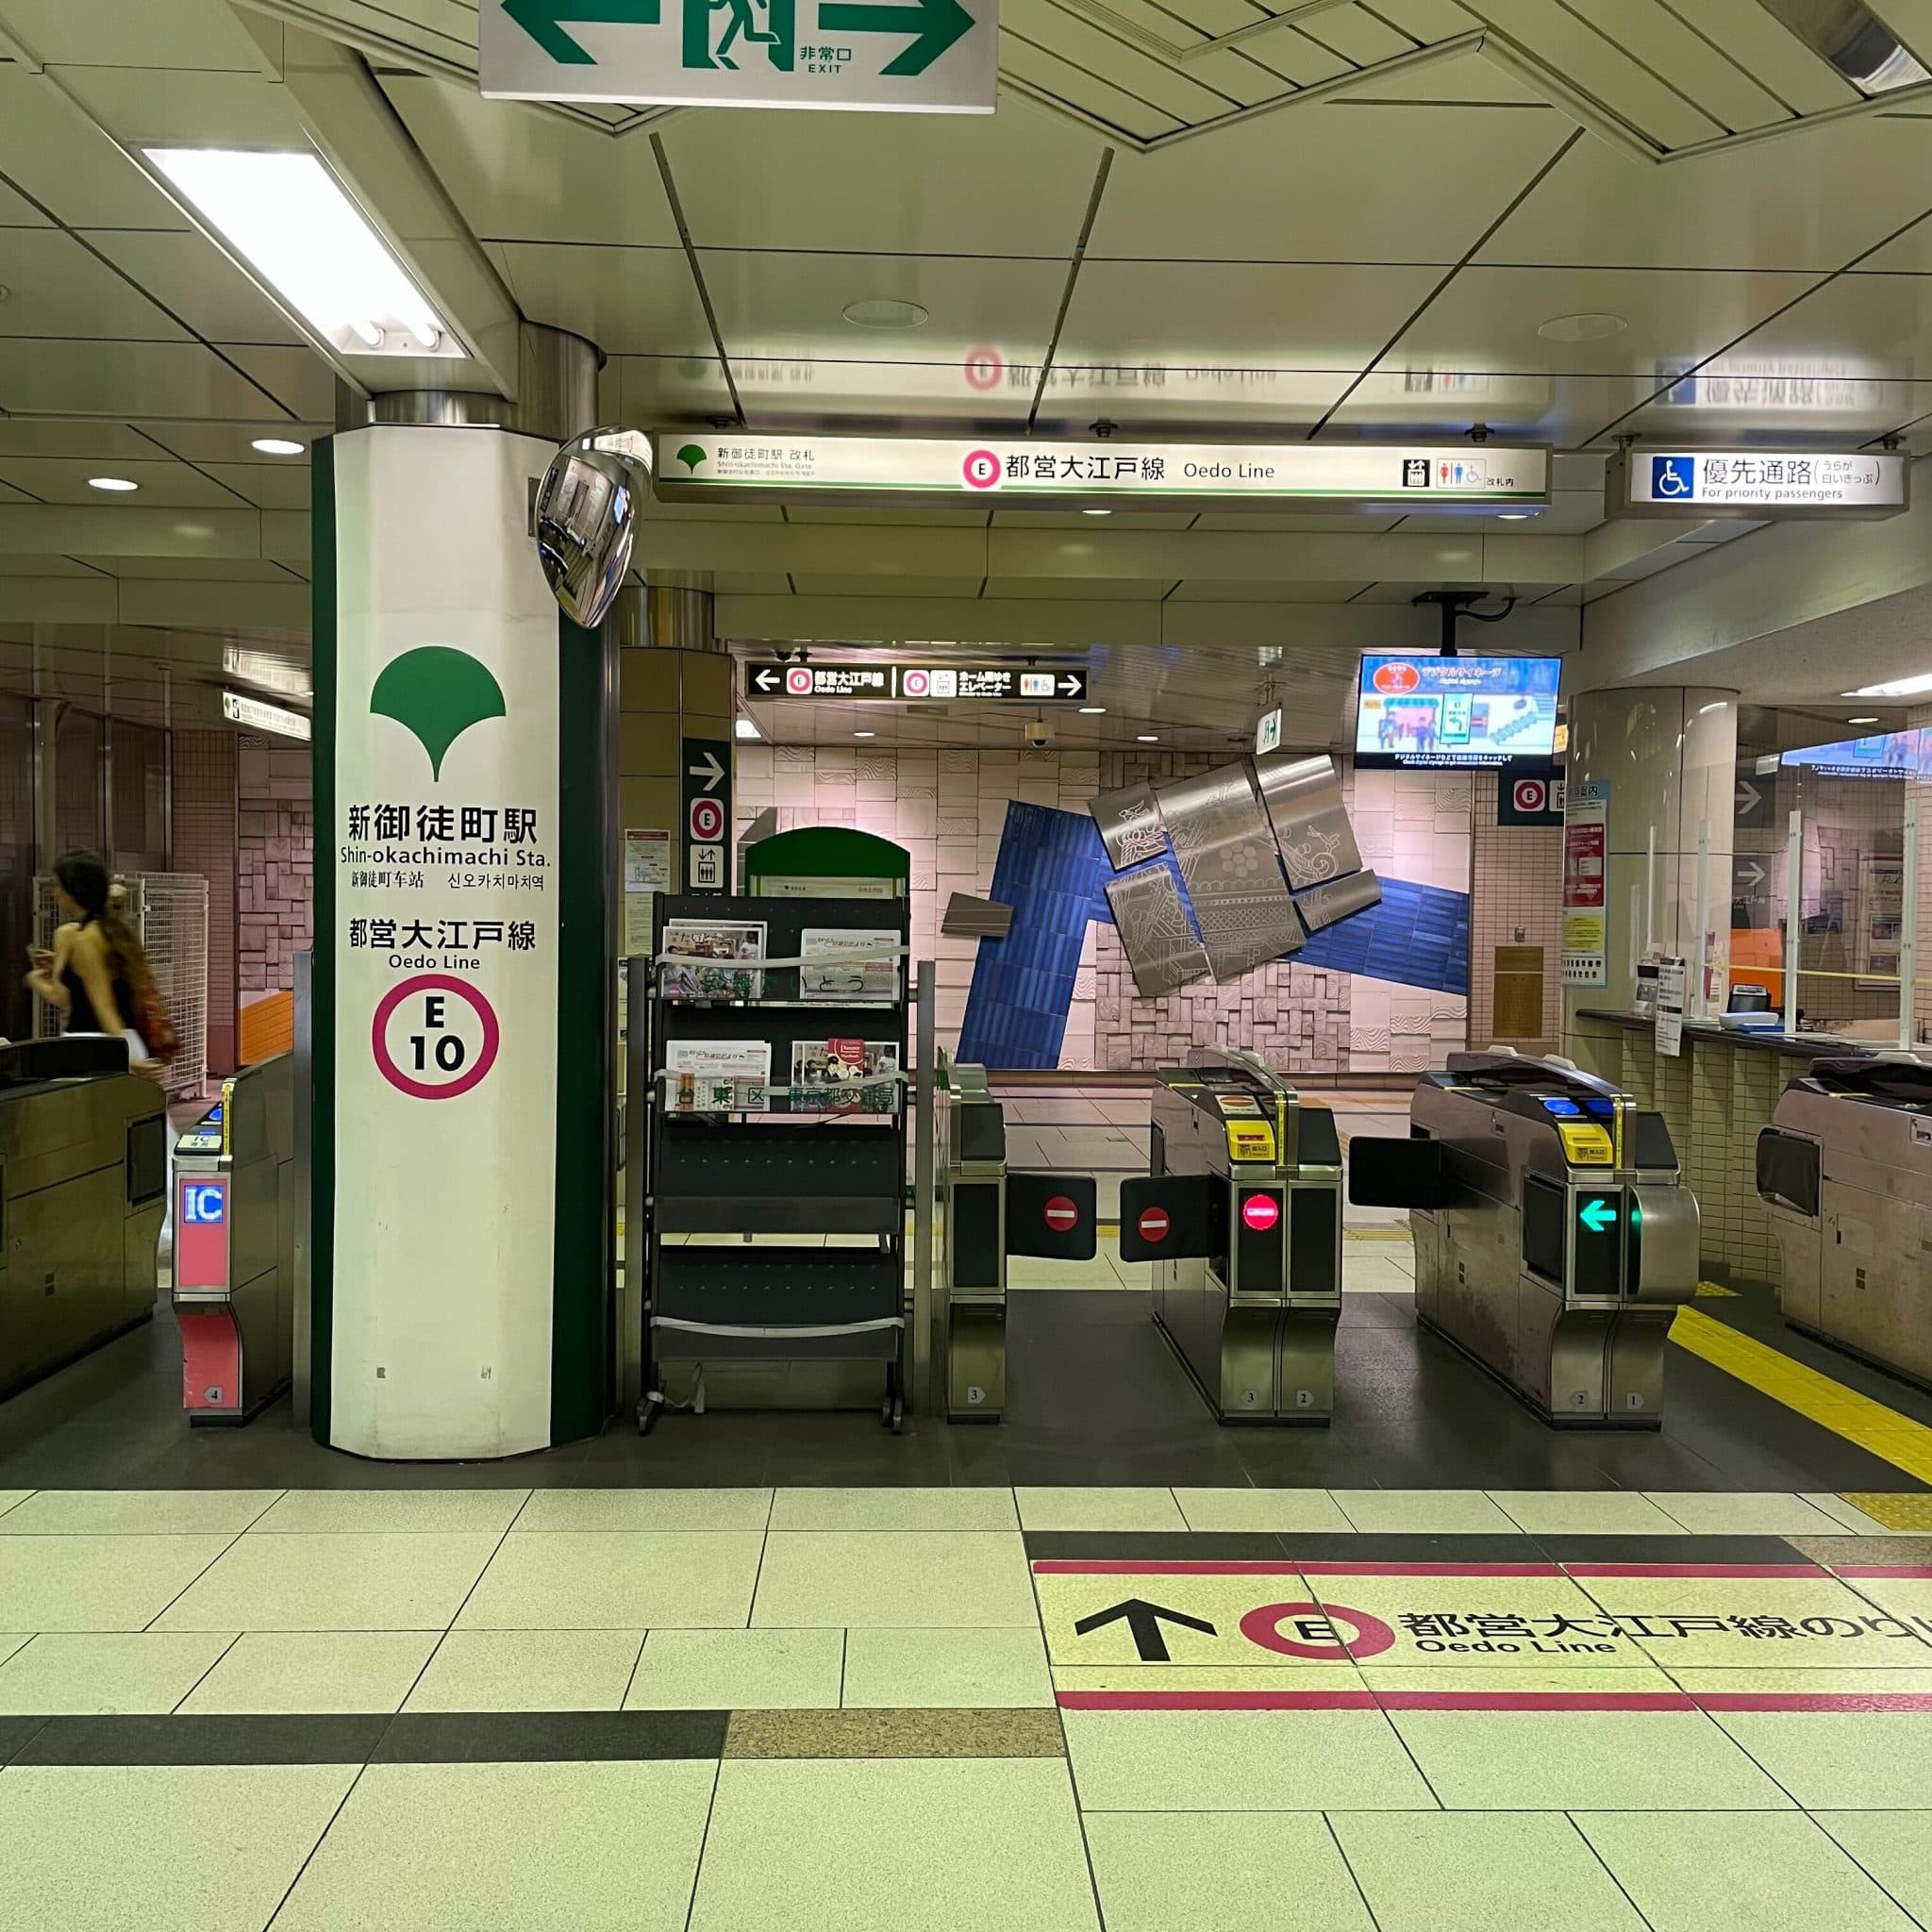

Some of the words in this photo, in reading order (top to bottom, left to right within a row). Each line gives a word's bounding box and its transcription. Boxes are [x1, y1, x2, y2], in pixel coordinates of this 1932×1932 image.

[799, 45, 852, 60] 非常口
[808, 64, 841, 74] EXIT
[717, 447, 783, 460] 新御徒町駅
[790, 449, 815, 461] 改札
[978, 462, 986, 475] E
[1006, 455, 1166, 481] 都営大江戸線
[1184, 462, 1232, 478] Oedo
[1239, 462, 1275, 478] Line
[1703, 458, 1812, 485] 優先通路
[1824, 460, 1853, 471] うらが
[1486, 477, 1514, 488] 改札内
[1702, 487, 1724, 498] For
[1725, 487, 1772, 501] priority
[1774, 489, 1843, 501] passengers
[814, 671, 884, 687] 都営大江戸線
[1526, 791, 1533, 801] E
[348, 804, 538, 844] 新御徒町駅
[704, 813, 710, 826] E
[341, 845, 509, 866] Shin-okachimachi
[516, 850, 551, 867] Sta.
[351, 870, 425, 889] 新御徒町车站
[447, 873, 544, 891] 신오카치마치역
[348, 918, 537, 951] 都営大江戸線
[388, 954, 437, 969] Oedo
[443, 955, 481, 970] Line
[425, 996, 444, 1028] E
[409, 1035, 465, 1072] 10
[186, 1189, 223, 1221] IC
[971, 1390, 978, 1401] 3
[1247, 1392, 1255, 1403] 3
[1301, 1392, 1307, 1404] 2
[1577, 1394, 1584, 1405] 2
[1631, 1395, 1636, 1406] 1
[1293, 1621, 1338, 1641] E
[1415, 1640, 1521, 1653] Oedo
[1529, 1640, 1617, 1654] Line
